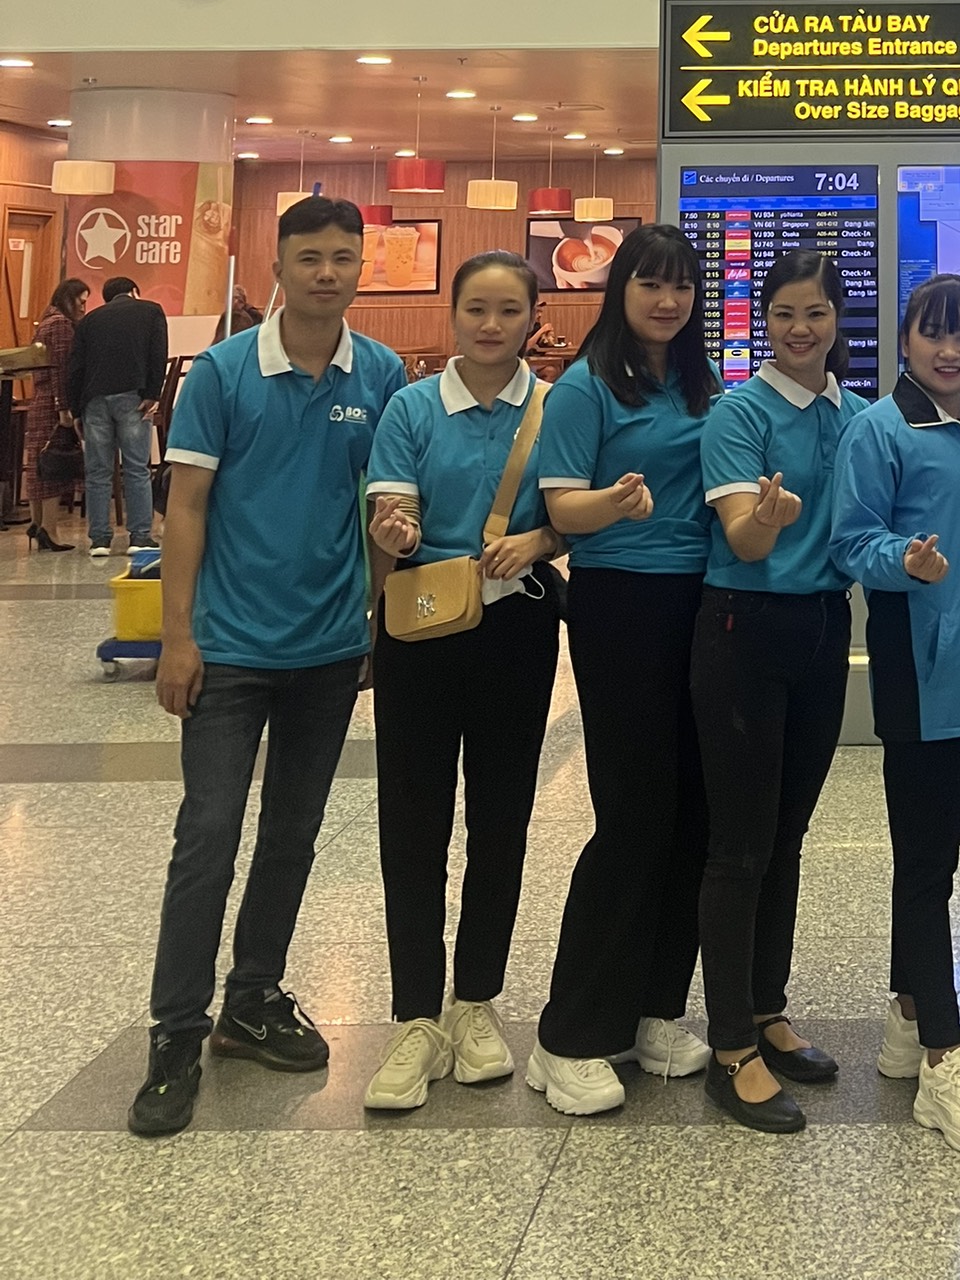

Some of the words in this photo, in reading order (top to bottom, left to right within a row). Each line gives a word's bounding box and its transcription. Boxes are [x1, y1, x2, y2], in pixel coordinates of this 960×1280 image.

[754, 10, 799, 33] CỬA
[804, 16, 834, 33] RA
[838, 8, 882, 33] TÀU
[887, 15, 930, 32] BAY
[753, 39, 863, 60] Departures
[868, 37, 958, 56] Entrance
[738, 71, 791, 97] KIỂM
[795, 79, 839, 97] TRA
[844, 74, 903, 97] HÀNH
[909, 74, 937, 96] LÝ
[794, 102, 842, 120] Over
[846, 101, 889, 119] Size
[699, 174, 714, 183] Các
[742, 174, 750, 183] đi
[755, 174, 794, 184] Departures
[815, 173, 859, 191] 7:04
[841, 269, 871, 277] Check-In
